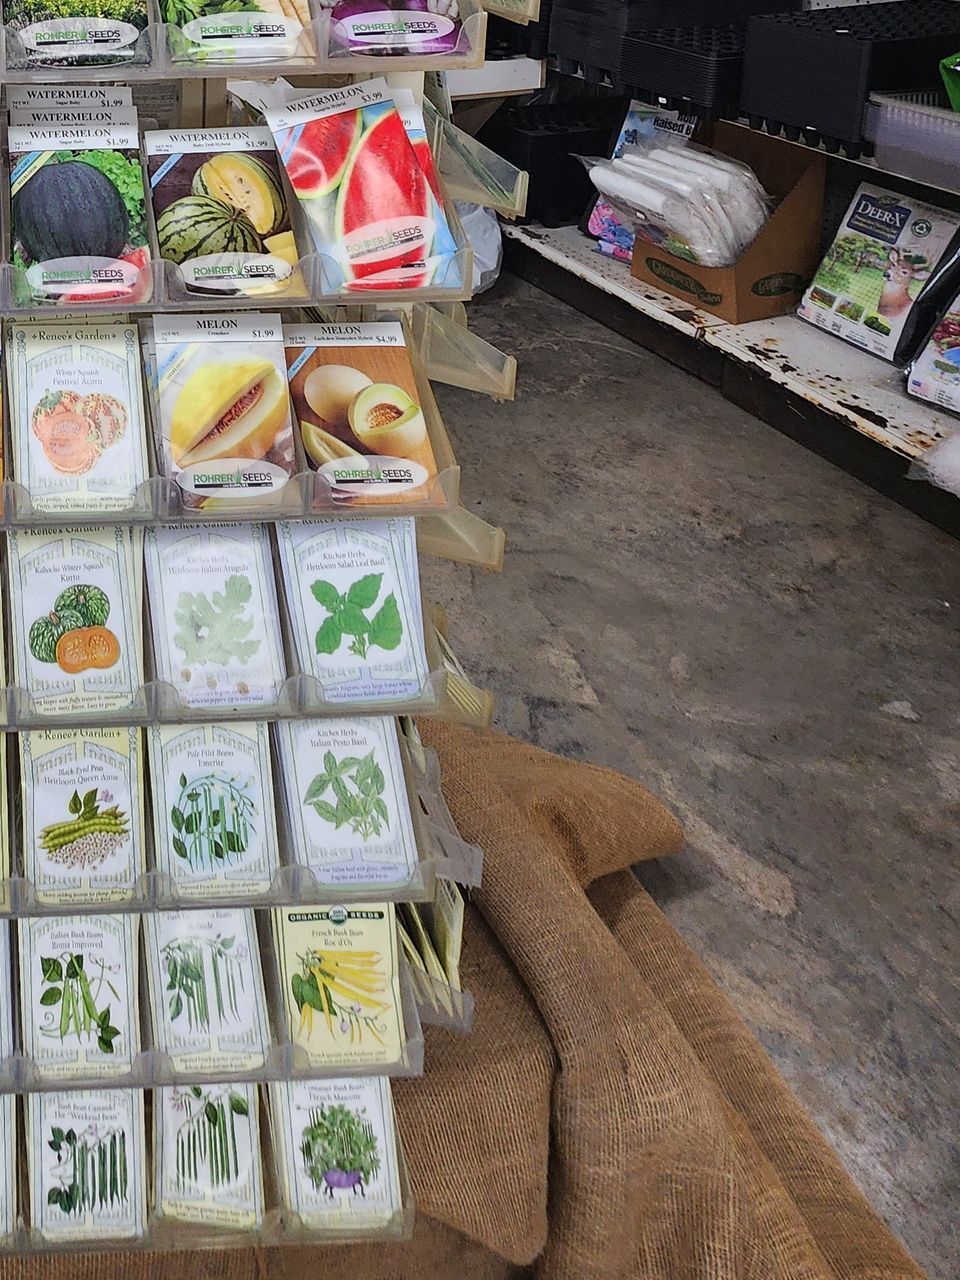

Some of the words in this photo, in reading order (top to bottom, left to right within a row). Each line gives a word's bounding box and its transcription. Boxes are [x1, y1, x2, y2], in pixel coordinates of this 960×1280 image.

[201, 26, 243, 35] ROHRER
[253, 24, 285, 34] SEEDS
[352, 22, 396, 32] ROHRER
[404, 20, 437, 30] SEEDS
[35, 32, 78, 41] ROHRER
[88, 30, 120, 39] SEEDS
[27, 89, 106, 99] WATERMELON
[101, 99, 123, 108] $1.99
[286, 86, 365, 114] WATERMELON
[31, 111, 112, 122] WATERMELON
[29, 128, 111, 139] WATERMELON
[169, 131, 249, 142] WATERMELON
[106, 137, 129, 146] $1.99
[245, 140, 268, 148] $1.99
[855, 200, 904, 228] DEER-X
[346, 237, 385, 253] ROHRER
[391, 225, 422, 240] SEEDS
[41, 271, 83, 280] ROHRER
[92, 269, 123, 279] SEEDS
[193, 266, 234, 275] ROHRER
[243, 264, 275, 273] SEEDS
[196, 320, 238, 329] MELON
[321, 325, 361, 334] MELON
[38, 330, 72, 341] Renee's
[75, 329, 111, 341] Garden
[252, 329, 274, 338] $1.99
[375, 335, 397, 344] $4.99
[193, 473, 233, 483] ROHRER
[242, 473, 272, 482] SEEDS
[333, 470, 374, 479] ROHRER
[382, 468, 411, 478] SEEDS
[44, 728, 77, 740] Renee's
[80, 728, 115, 739] Garden
[311, 739, 331, 747] Italian
[332, 738, 351, 747] Pesto
[352, 737, 368, 747] Basil
[290, 913, 327, 921] ORGANIC
[350, 911, 380, 919] SEEDS
[52, 941, 70, 949] Roma
[71, 940, 103, 951] Improved
